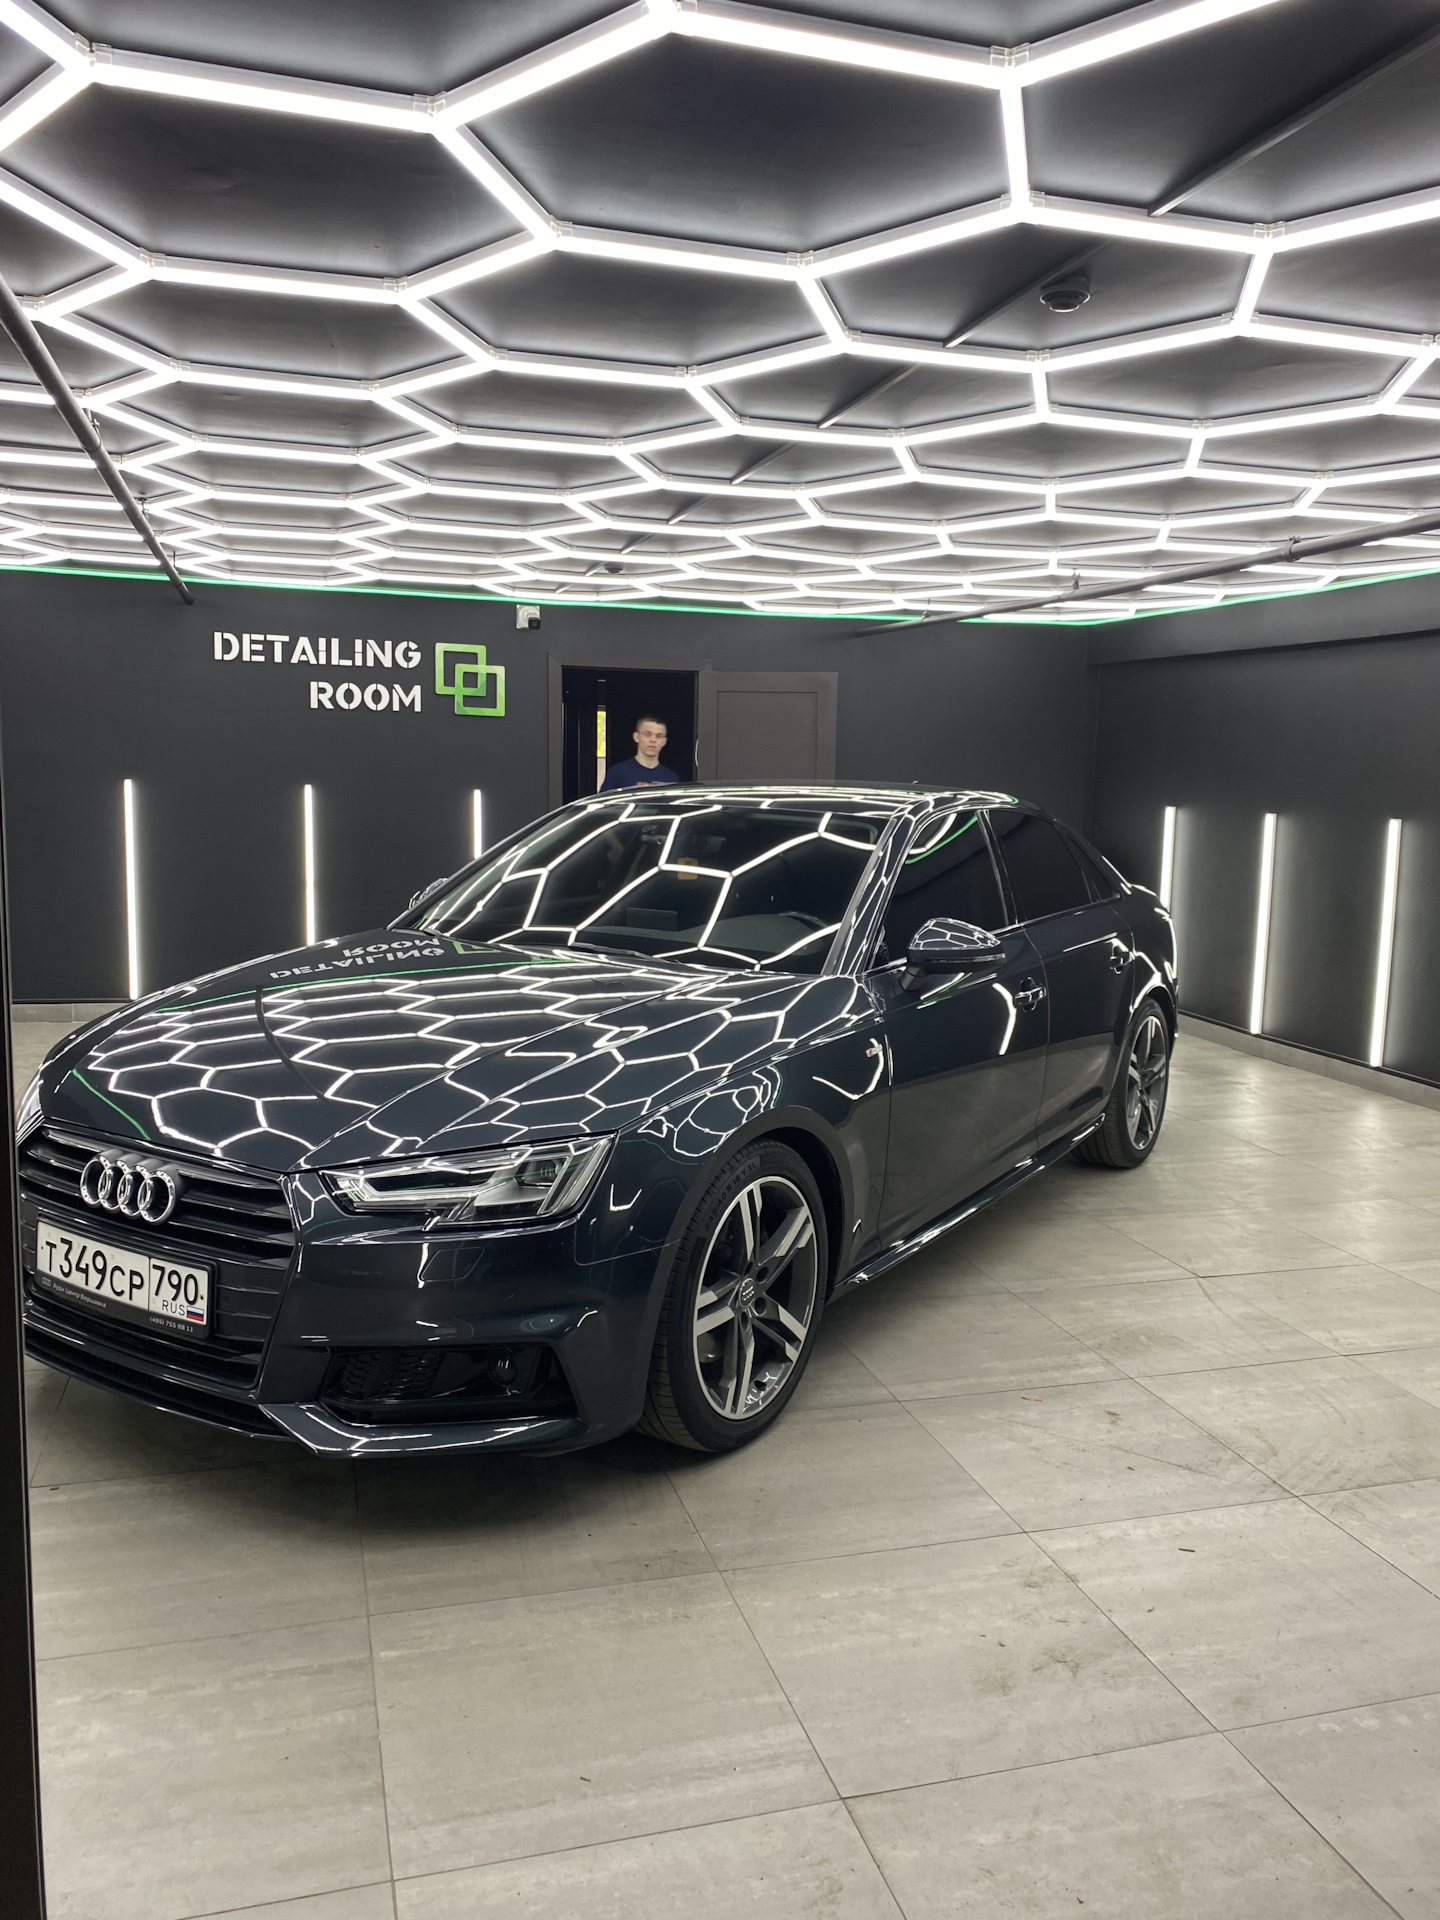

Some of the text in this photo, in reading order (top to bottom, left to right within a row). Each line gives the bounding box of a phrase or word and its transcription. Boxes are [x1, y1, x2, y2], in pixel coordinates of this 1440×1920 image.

[213, 631, 422, 669] DETAILING
[309, 681, 422, 713] ROOM
[152, 1264, 199, 1306] 790
[162, 1299, 186, 1316] RUS
